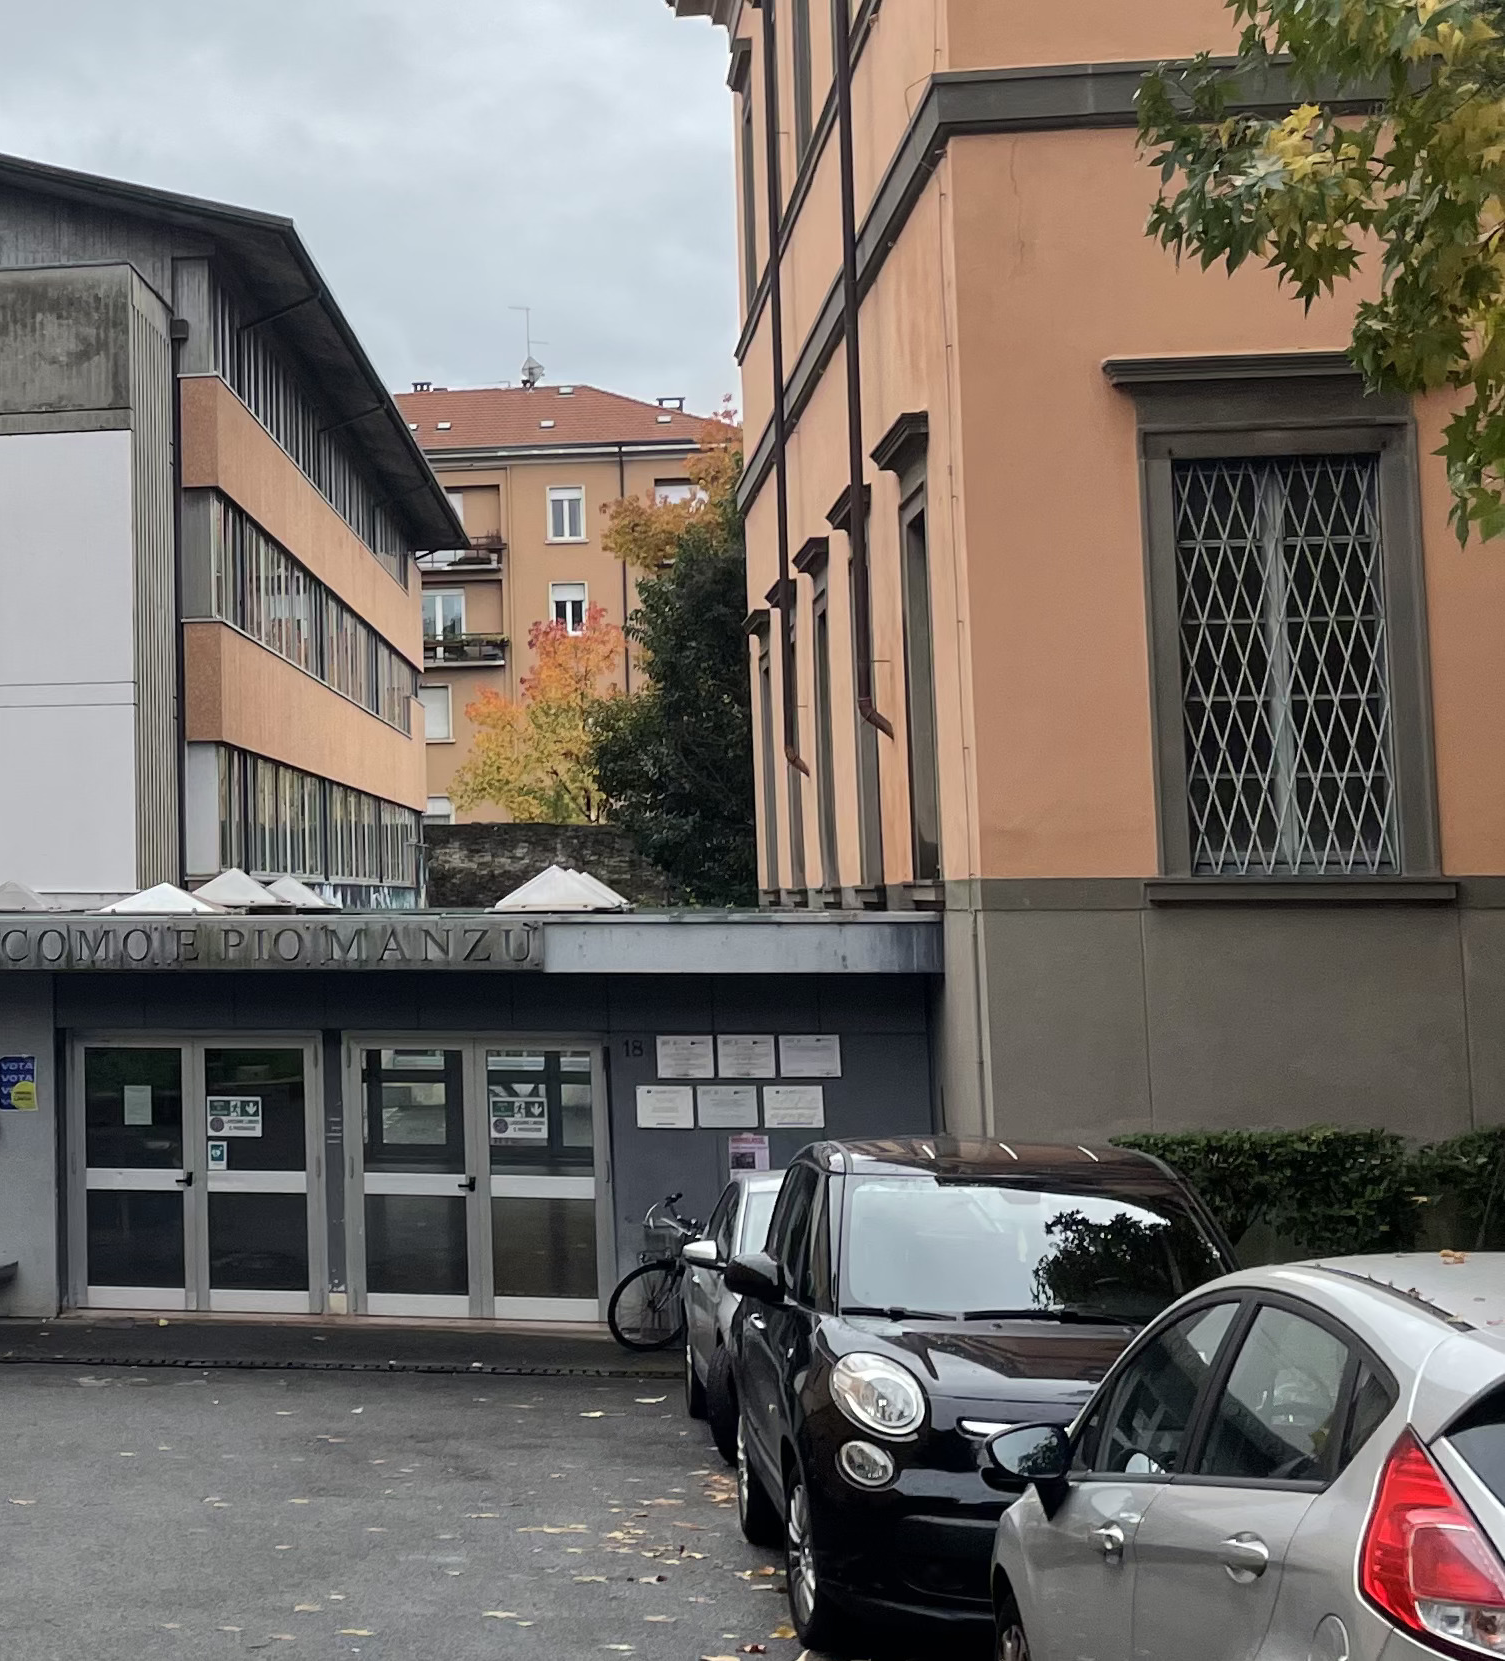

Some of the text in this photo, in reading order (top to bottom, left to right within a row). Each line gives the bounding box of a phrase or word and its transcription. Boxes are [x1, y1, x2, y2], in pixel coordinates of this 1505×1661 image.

[173, 928, 200, 962] E
[220, 928, 301, 962] PIO
[623, 1039, 644, 1057] 18
[1, 1062, 33, 1070] VOTA
[1, 1074, 33, 1082] VOTA
